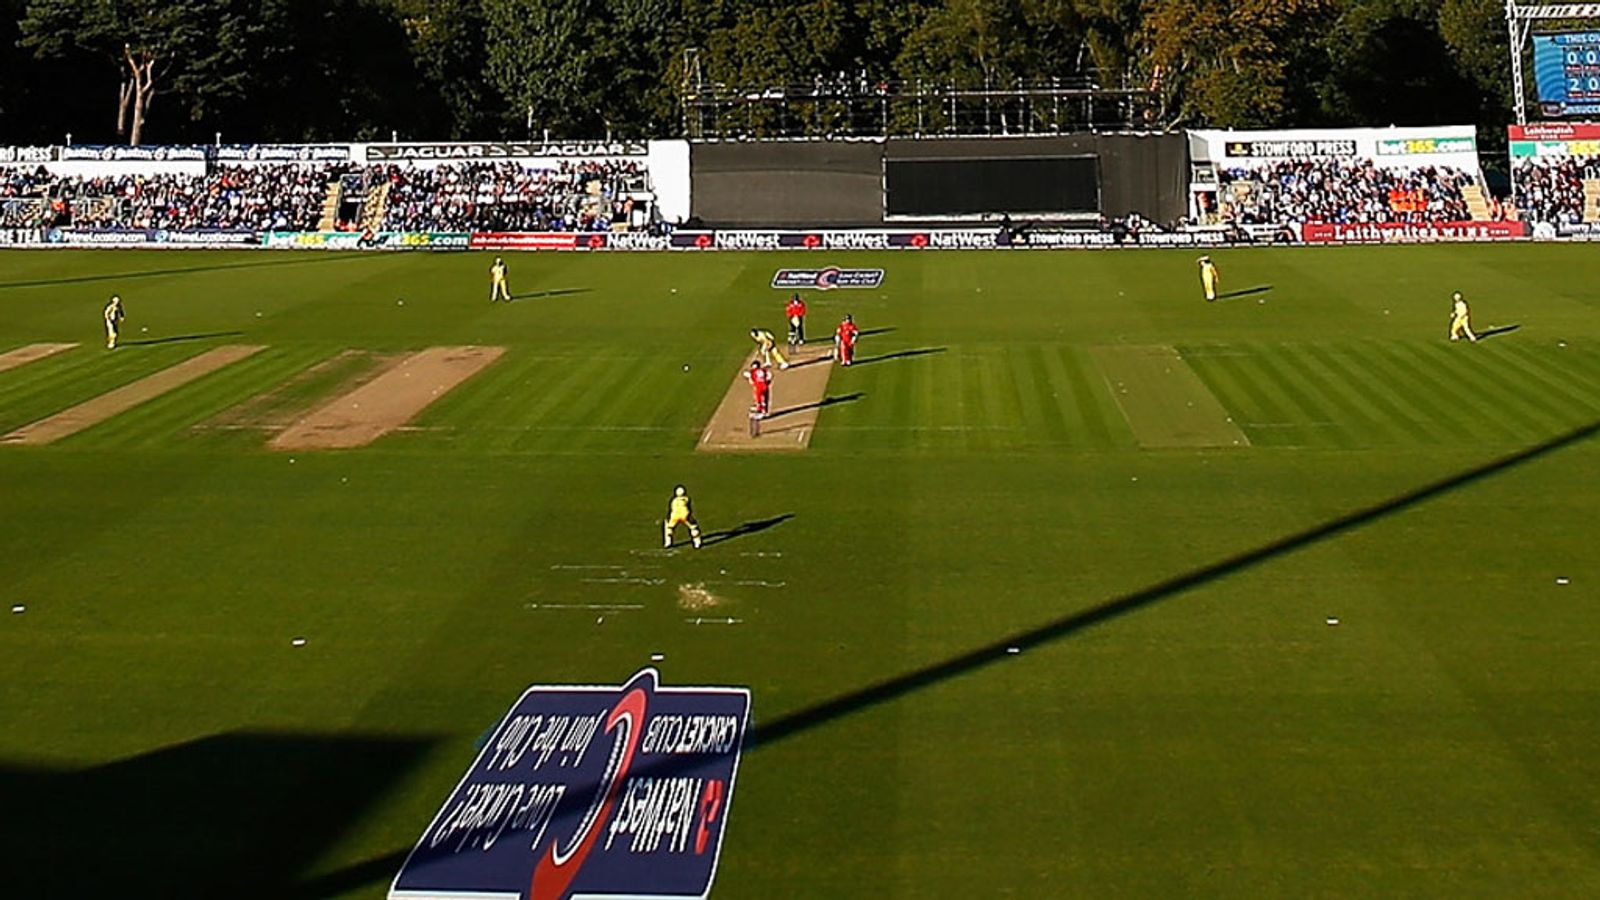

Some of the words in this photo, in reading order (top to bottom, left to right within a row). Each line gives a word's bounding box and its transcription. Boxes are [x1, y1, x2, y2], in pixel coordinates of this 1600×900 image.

[1570, 78, 1580, 91] 2
[17, 145, 52, 162] PRESS
[388, 147, 487, 158] JAGUAR
[533, 144, 625, 156] JAGUAR
[1251, 141, 1315, 157] STOWFORD
[1317, 140, 1354, 156] PRESS
[1377, 138, 1473, 154] bet365.com
[17, 229, 41, 243] TEA
[930, 233, 997, 246] NatWest
[1028, 232, 1077, 244] STOWFORD
[1079, 232, 1114, 244] PRESS
[1139, 232, 1191, 244] STOWFORD
[1193, 232, 1225, 243] PRESS
[1443, 226, 1489, 238] WINE
[606, 232, 672, 248] NatWest
[714, 233, 780, 247] NatWest
[823, 233, 889, 247] NatWest
[486, 715, 541, 771] Club
[534, 715, 569, 770] the
[561, 709, 607, 768] Join
[429, 783, 524, 853] Cricket?
[510, 784, 566, 850] Love
[605, 777, 702, 853] NatWest
